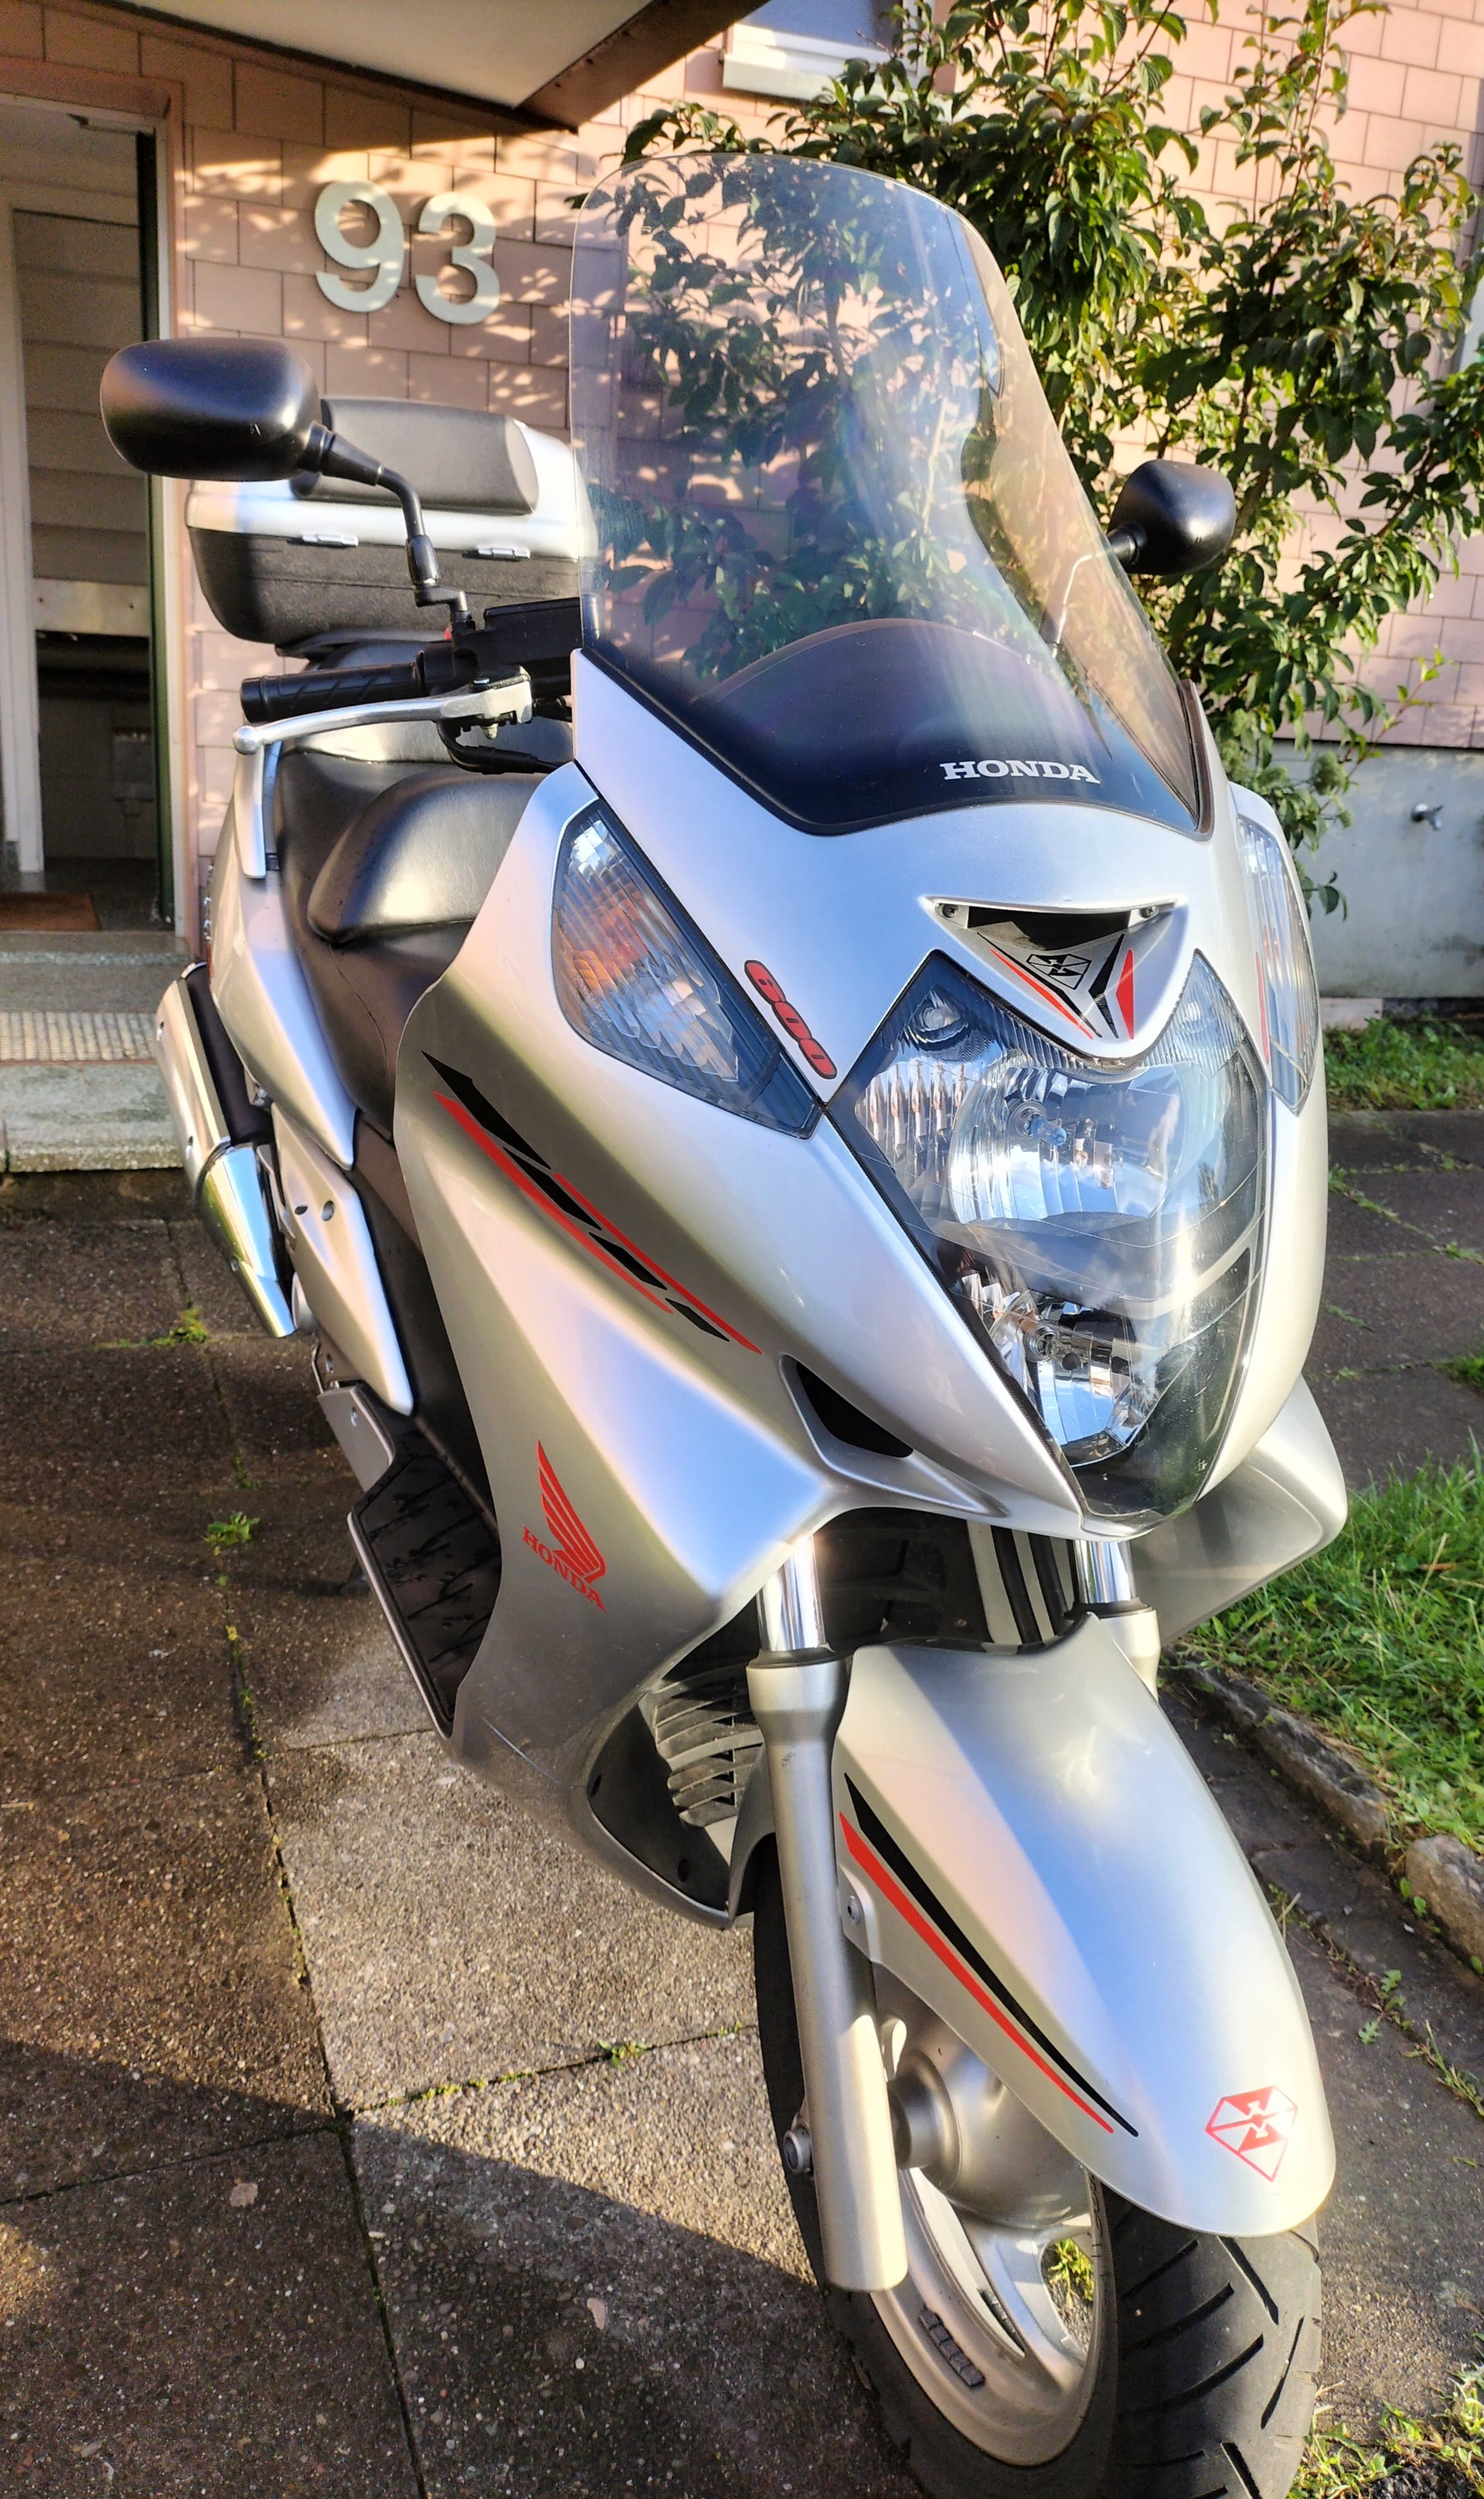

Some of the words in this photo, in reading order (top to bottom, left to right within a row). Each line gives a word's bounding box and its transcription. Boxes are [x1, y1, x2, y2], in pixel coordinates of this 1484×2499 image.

[315, 181, 500, 325] 93
[939, 760, 1101, 785] HONDA
[744, 960, 837, 1079] 600
[522, 1525, 607, 1612] HONDA
